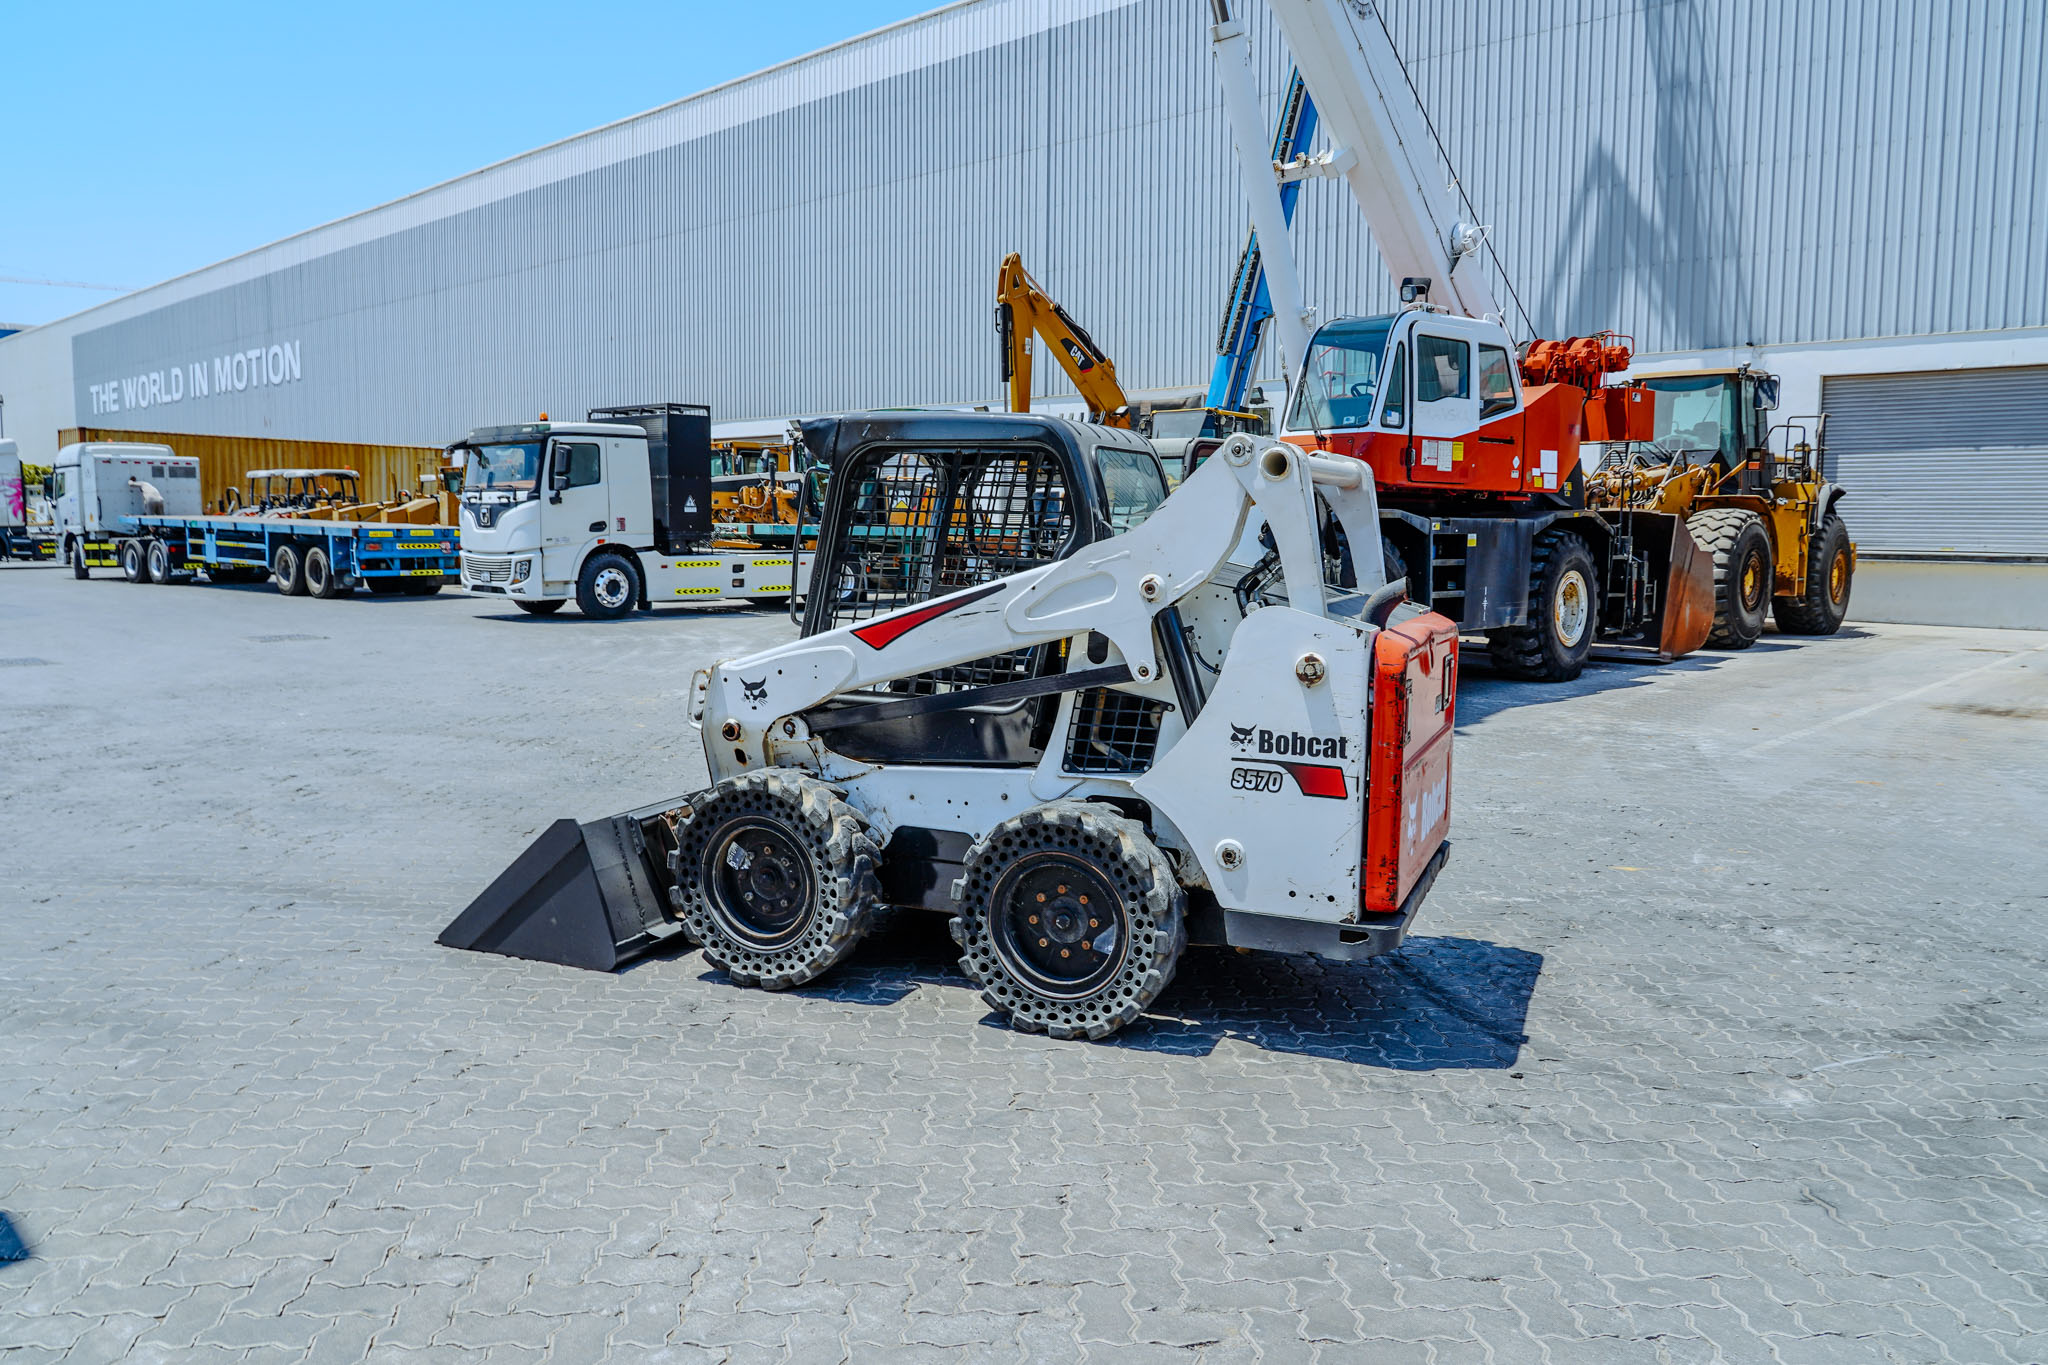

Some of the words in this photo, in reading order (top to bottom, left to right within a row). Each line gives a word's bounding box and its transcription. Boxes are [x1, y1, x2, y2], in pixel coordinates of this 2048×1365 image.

[1070, 345, 1085, 366] CAT
[90, 381, 119, 415] THE
[122, 367, 184, 409] WORLD
[189, 361, 209, 398] IN
[214, 339, 301, 393] MOTION
[1258, 729, 1348, 759] Bobcat
[1230, 767, 1283, 793] S570
